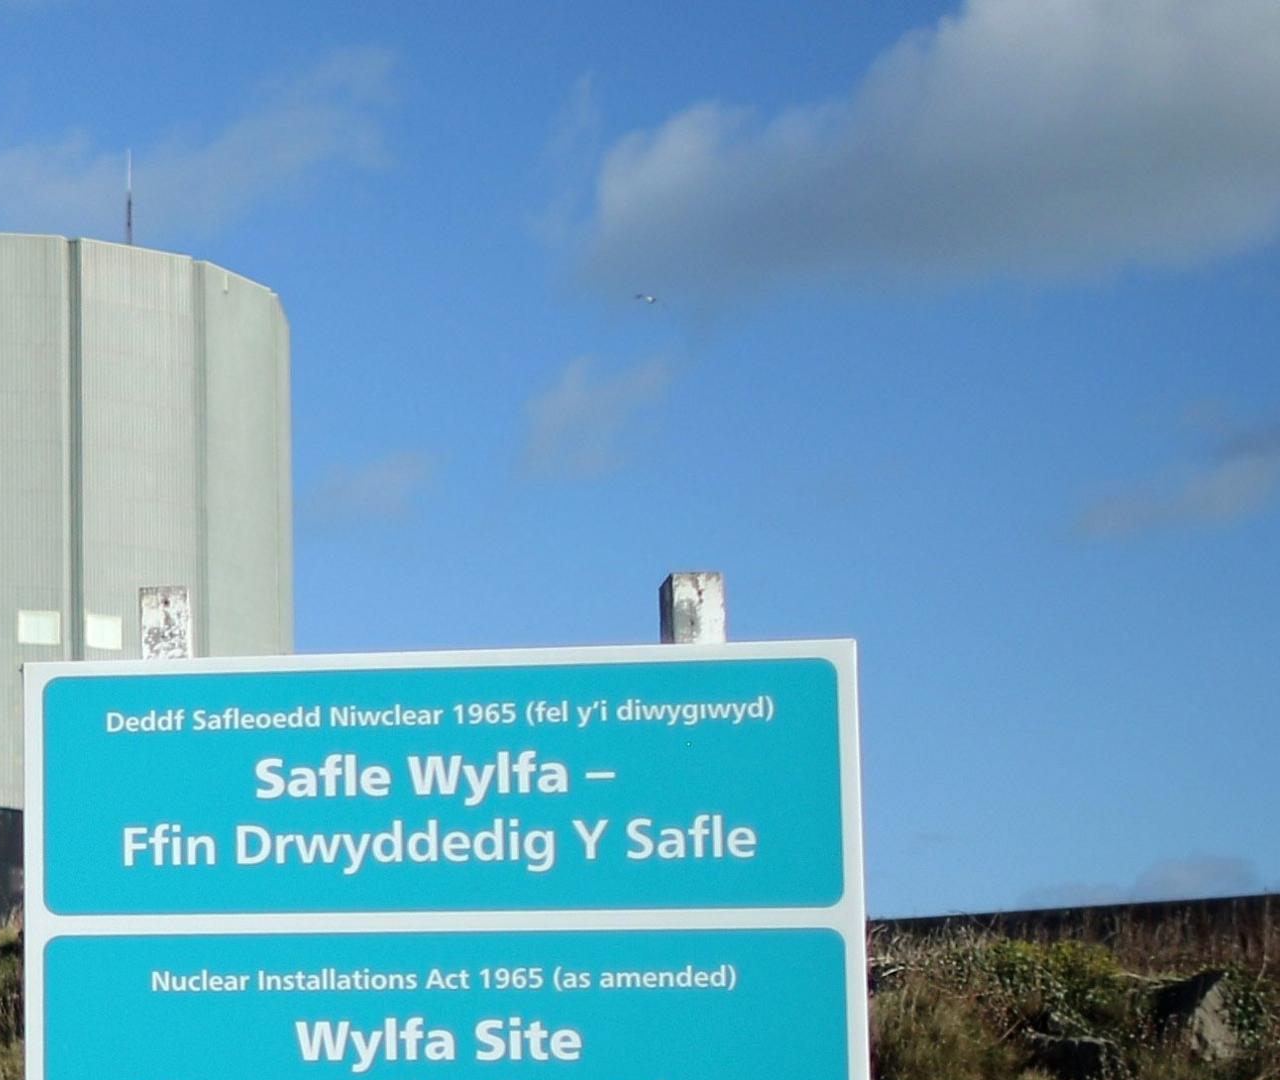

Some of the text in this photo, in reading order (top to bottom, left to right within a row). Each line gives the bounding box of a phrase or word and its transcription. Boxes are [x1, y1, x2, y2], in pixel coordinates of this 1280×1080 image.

[106, 695, 775, 733] Deddf Safleoedd Niwclear 1965 (fel y'i diwygiwyd)
[254, 753, 392, 800] Safle
[407, 749, 569, 807] Wylfa
[123, 813, 758, 876] Ffin Drwyddedig Y Safle
[151, 964, 737, 992] Nuclear Installations Act 1965 (as amended)
[295, 1016, 583, 1073] Wylfa Site
